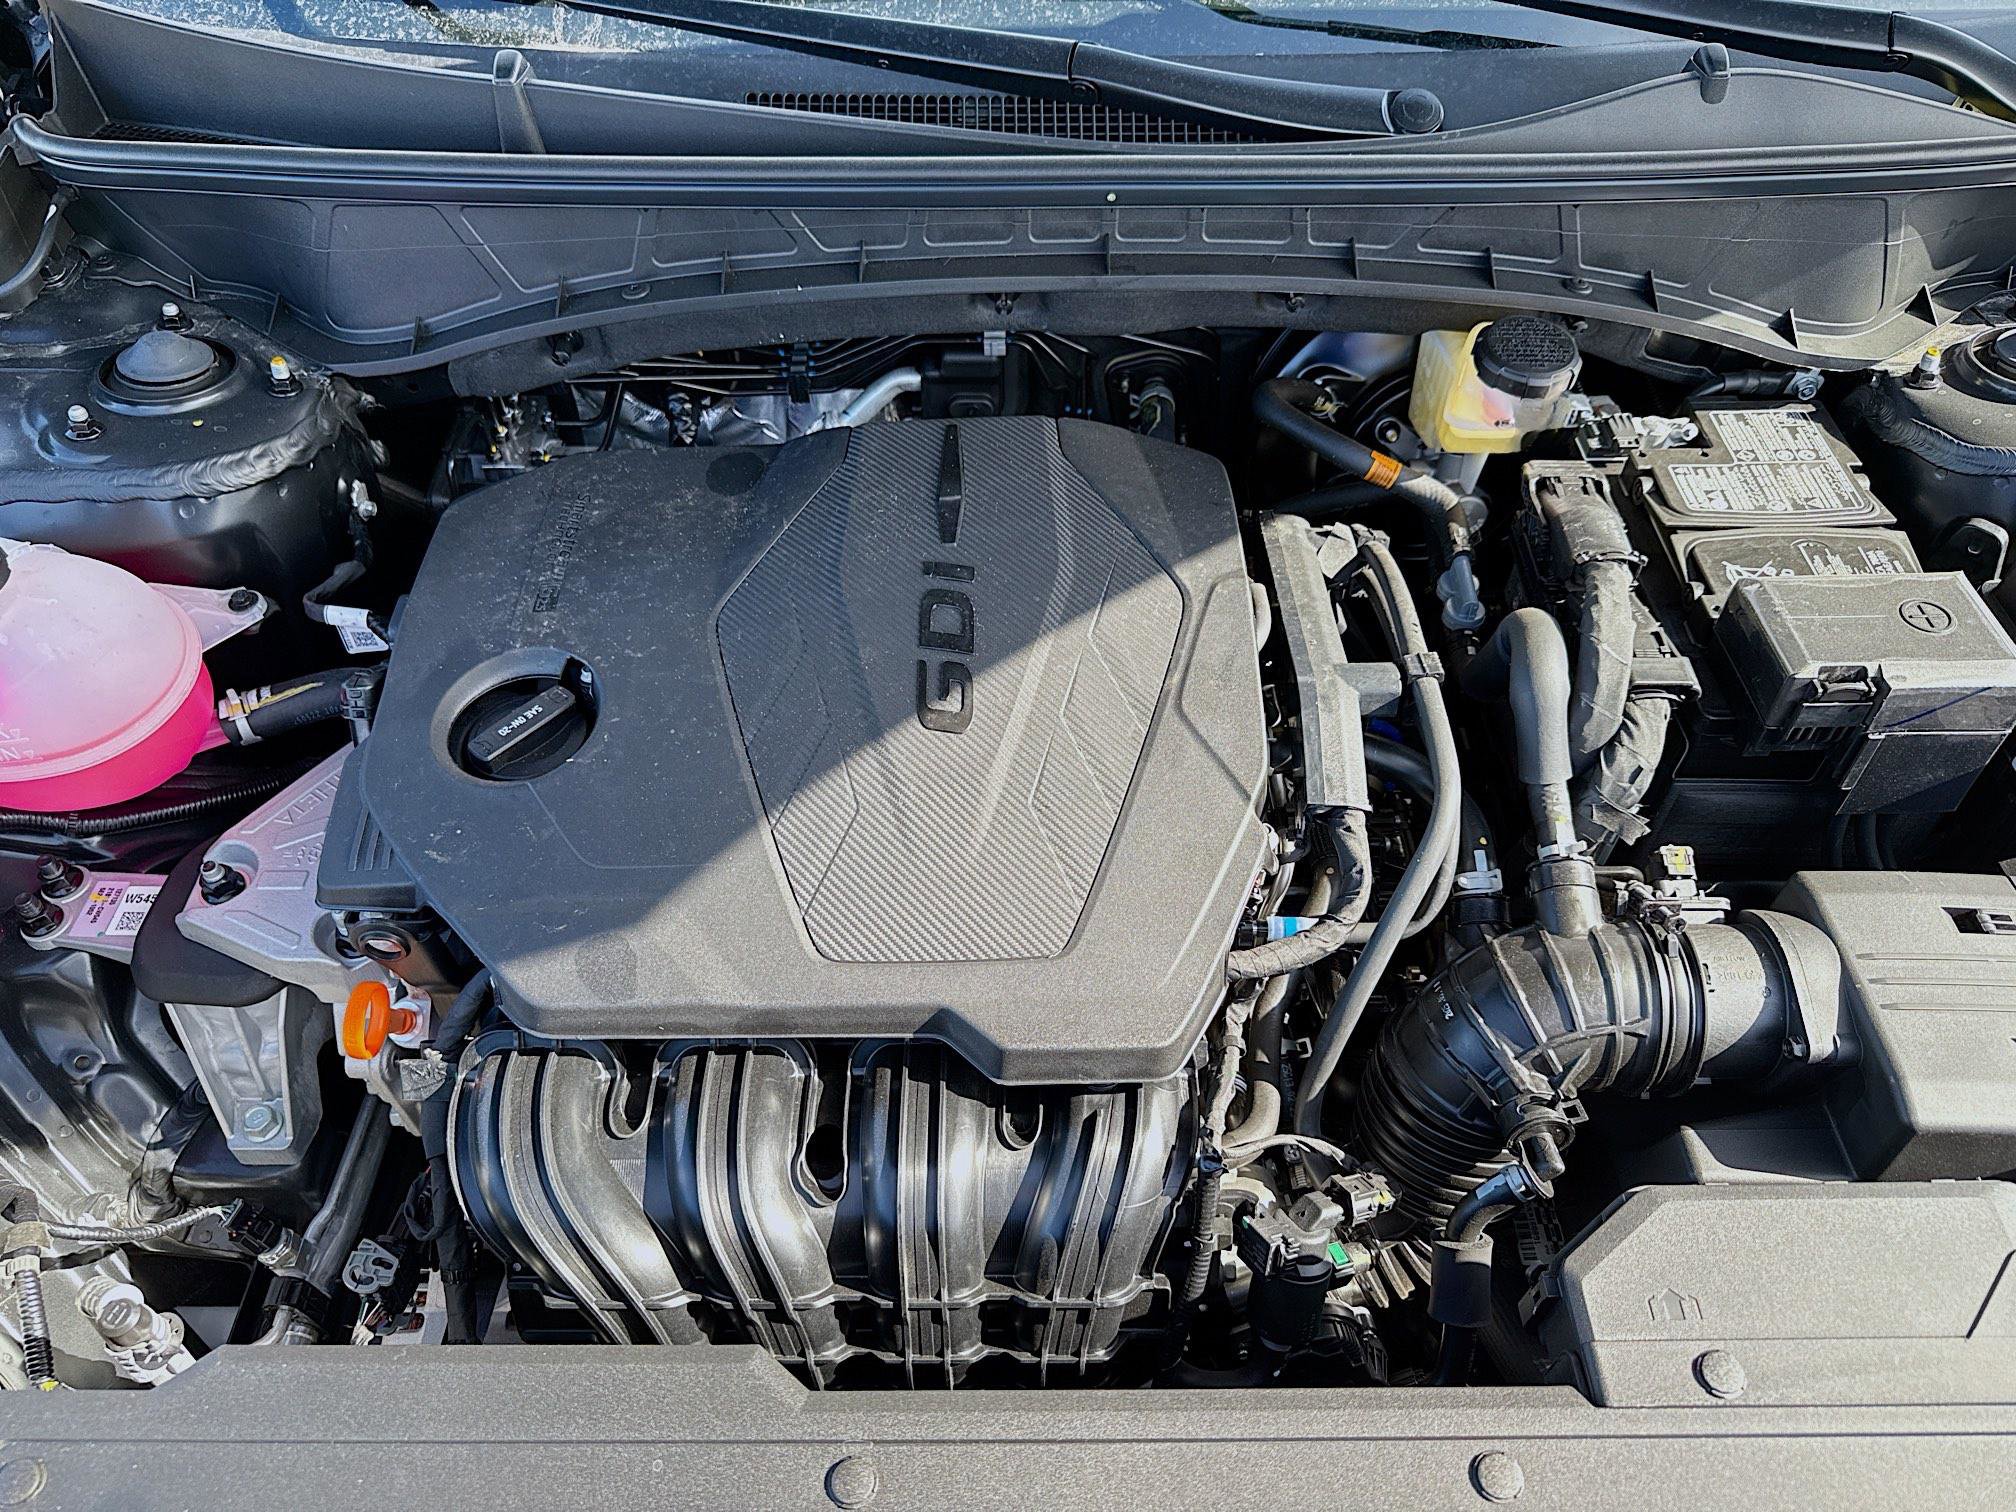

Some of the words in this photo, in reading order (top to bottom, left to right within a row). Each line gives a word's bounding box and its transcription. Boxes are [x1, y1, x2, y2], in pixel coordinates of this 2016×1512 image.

[551, 493, 591, 582] Smartstream
[523, 704, 543, 720] SAE
[497, 716, 527, 737] 0W-20
